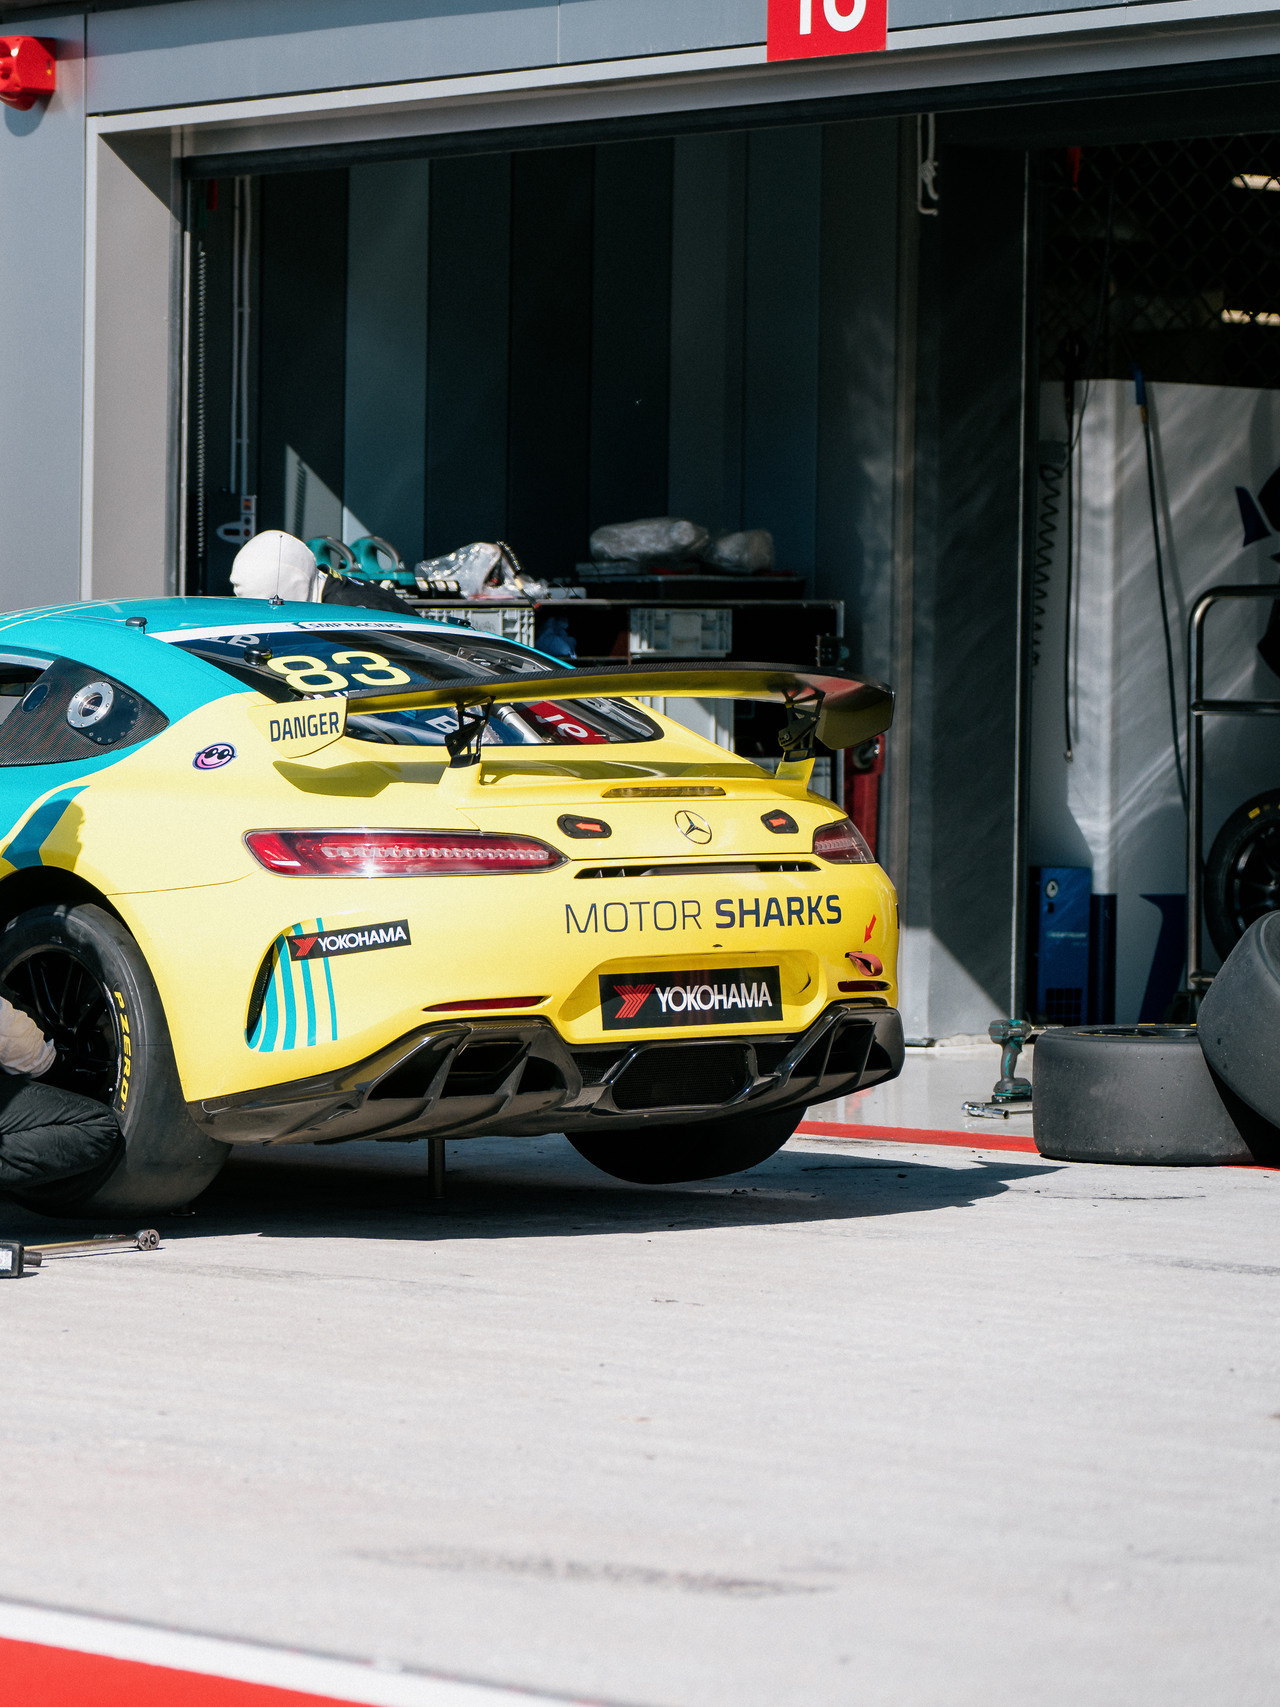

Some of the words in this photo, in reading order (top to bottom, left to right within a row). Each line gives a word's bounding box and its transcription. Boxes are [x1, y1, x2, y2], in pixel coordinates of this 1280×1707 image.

[343, 622, 404, 630] RACING
[266, 651, 411, 693] 83
[270, 711, 340, 742] DANGER
[565, 899, 702, 934] MOTOR
[715, 894, 842, 929] SHARKS
[318, 925, 407, 952] YOKOHAMA
[113, 991, 126, 1009] P
[654, 982, 773, 1013] YOKOHAMA
[119, 1013, 132, 1103] ZERO
